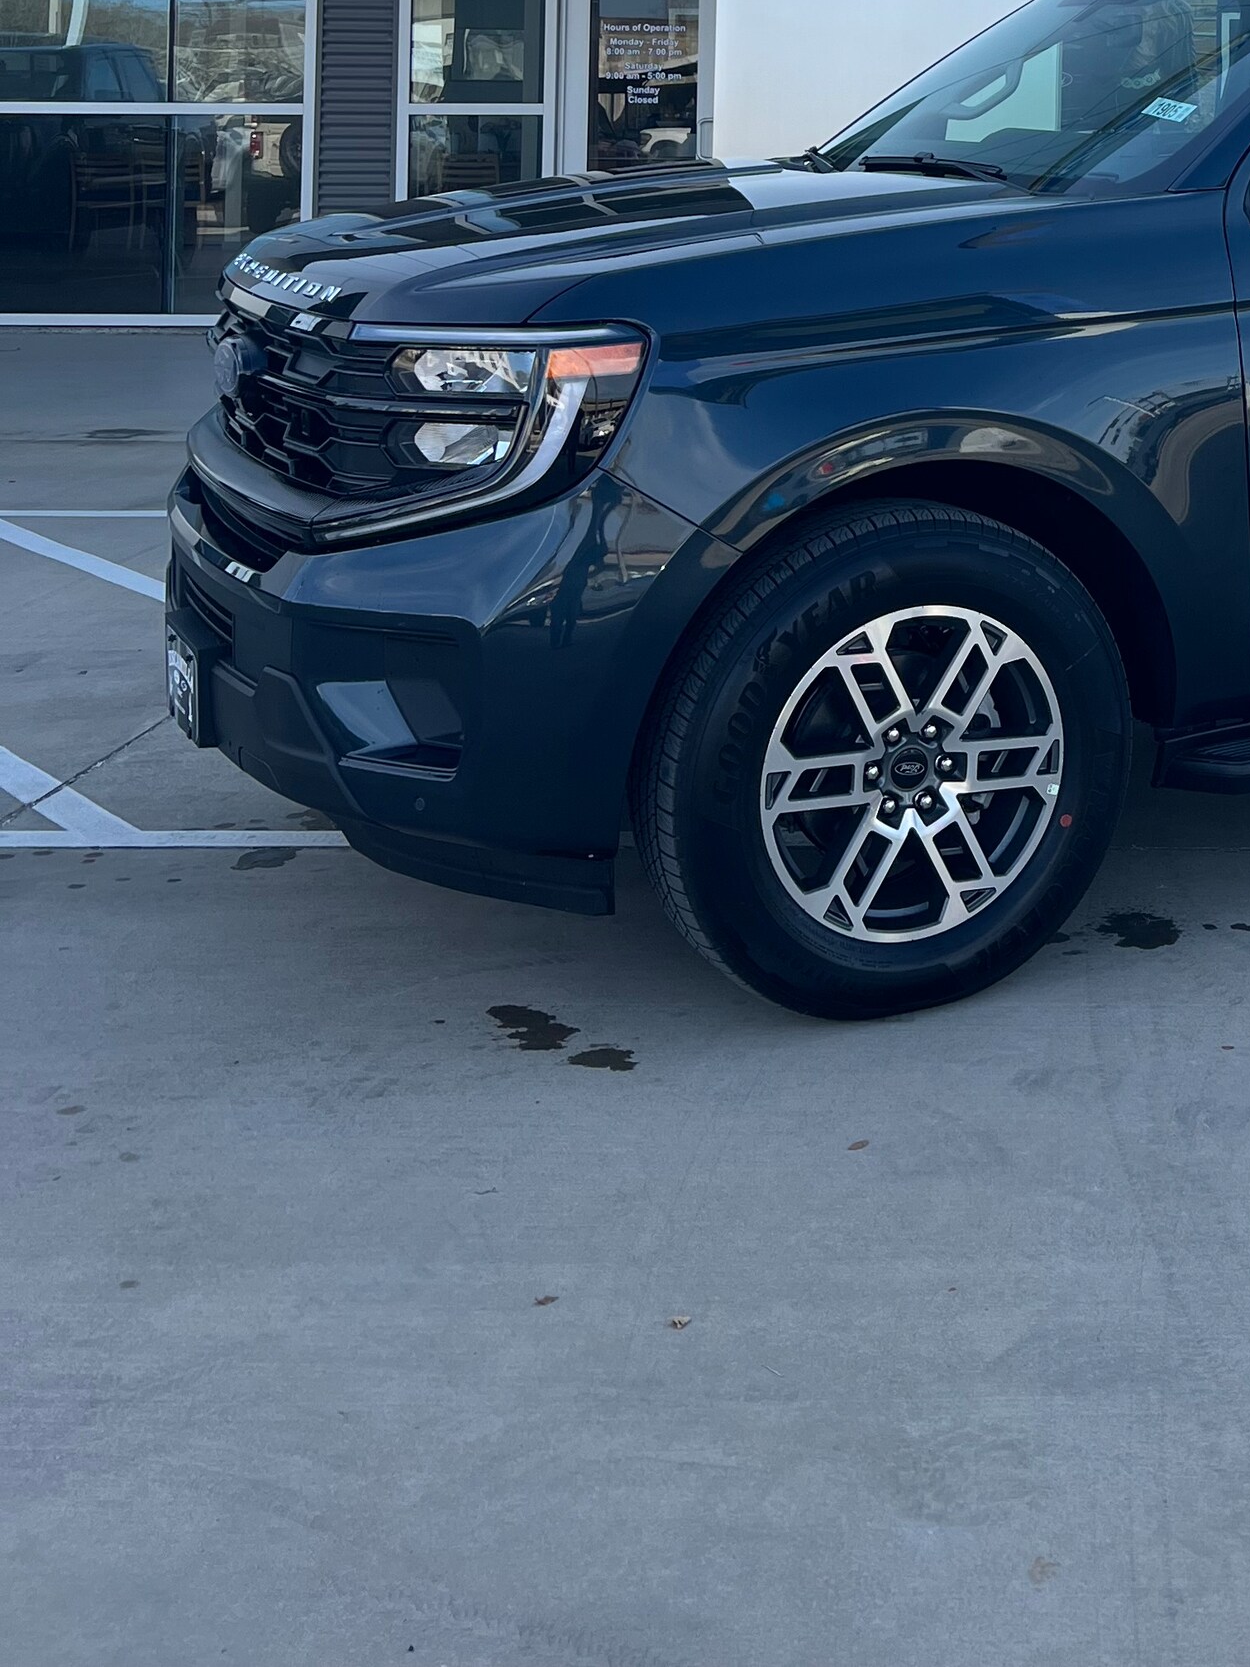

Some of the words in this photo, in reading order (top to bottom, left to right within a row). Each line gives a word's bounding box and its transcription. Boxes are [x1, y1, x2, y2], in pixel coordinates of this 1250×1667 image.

[604, 23, 630, 32] Hours
[632, 23, 641, 32] of
[643, 23, 686, 33] Operation
[609, 38, 644, 47] Monday
[652, 38, 679, 47] Friday
[668, 49, 682, 57] pm
[624, 62, 663, 71] Saturday
[605, 71, 624, 80] 9:00
[647, 72, 666, 80] 5:00
[667, 73, 682, 81] pm
[626, 86, 660, 95] Sunday
[627, 96, 659, 104] Closed
